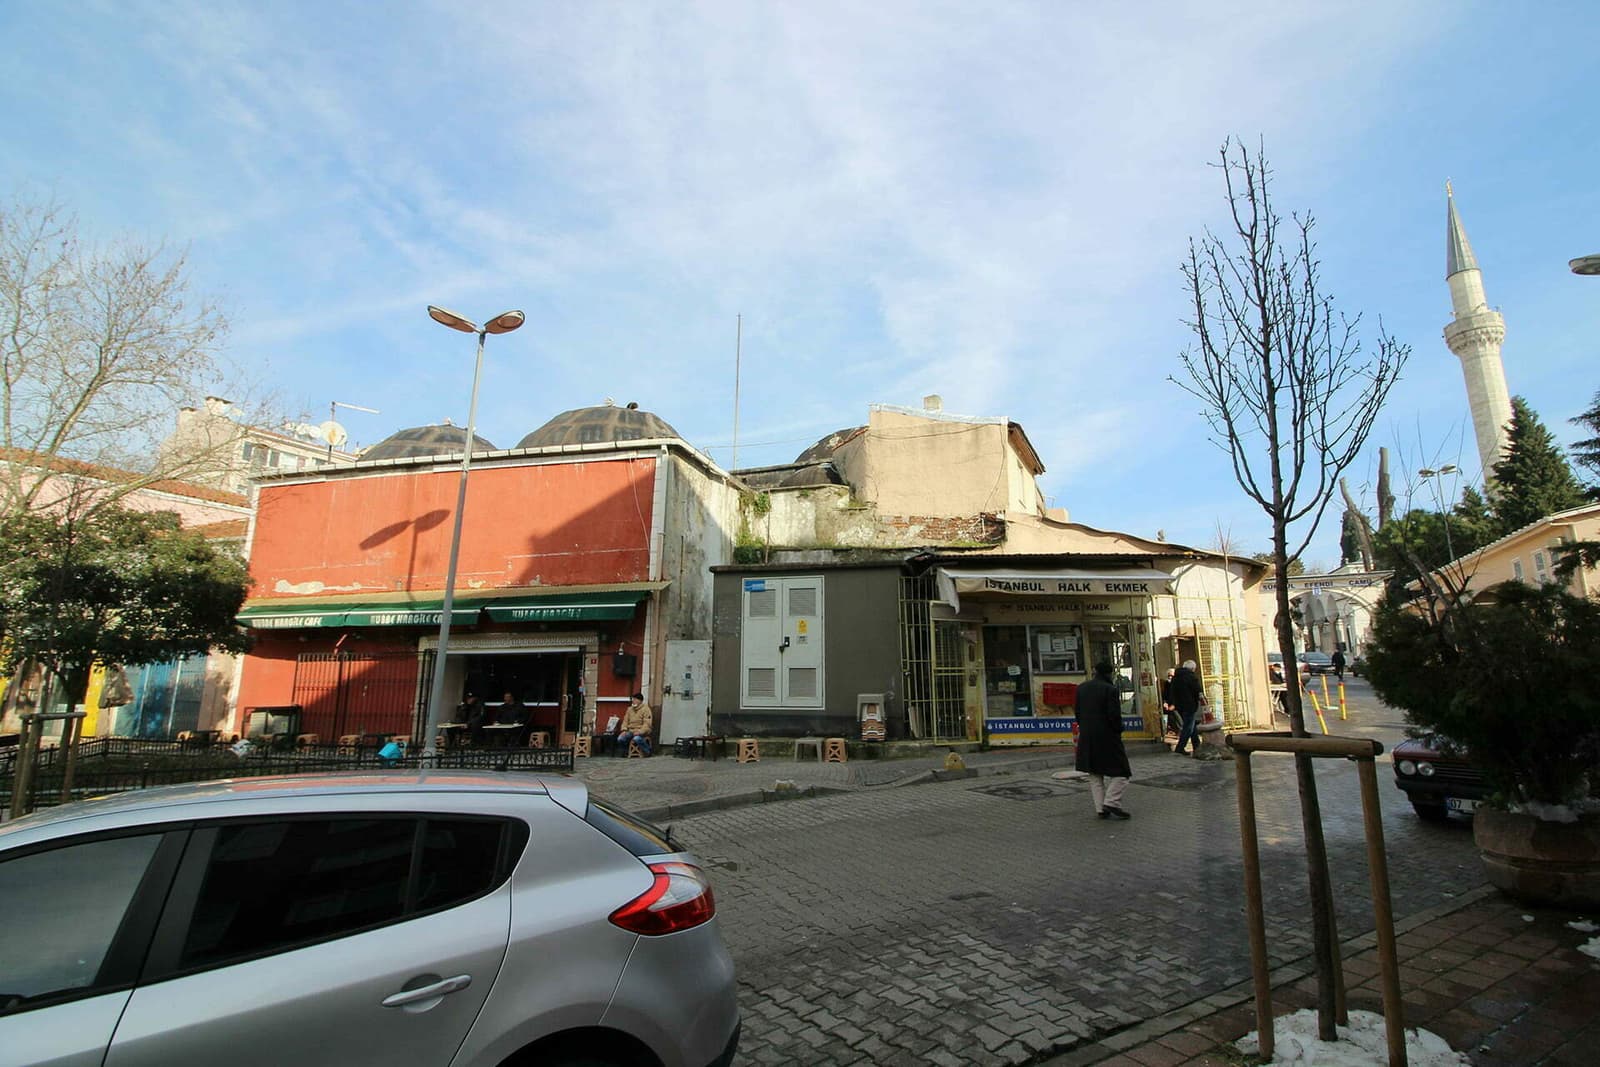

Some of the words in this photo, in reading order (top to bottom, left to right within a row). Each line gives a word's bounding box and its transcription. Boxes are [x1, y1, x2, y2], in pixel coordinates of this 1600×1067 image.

[985, 577, 1045, 592] İSTANBUL
[1058, 582, 1091, 592] HALK
[1105, 583, 1148, 592] EKMEK
[1086, 603, 1110, 611] KMEK
[304, 616, 322, 627] CAFE
[432, 614, 449, 624] CA
[994, 722, 1035, 730] İSTANBUL
